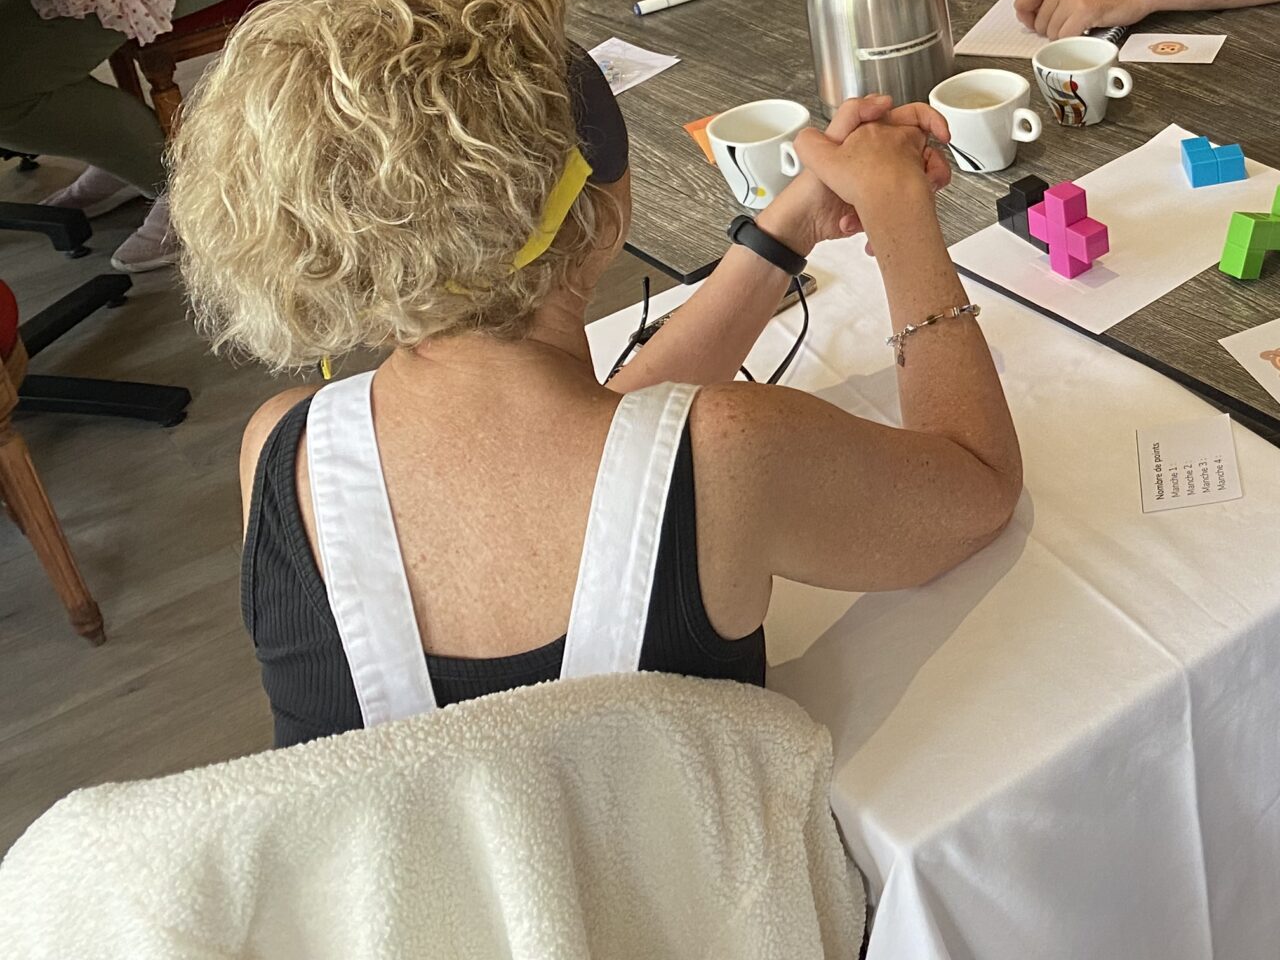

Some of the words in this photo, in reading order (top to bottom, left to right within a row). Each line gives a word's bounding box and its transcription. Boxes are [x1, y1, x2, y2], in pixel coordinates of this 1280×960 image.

[1152, 442, 1162, 462] points
[1154, 464, 1162, 472] de
[1200, 467, 1210, 493] Manche
[1216, 464, 1226, 491] Manche
[1155, 473, 1165, 500] Nombre
[1170, 473, 1180, 498] Manche
[1185, 470, 1195, 496] Manche
